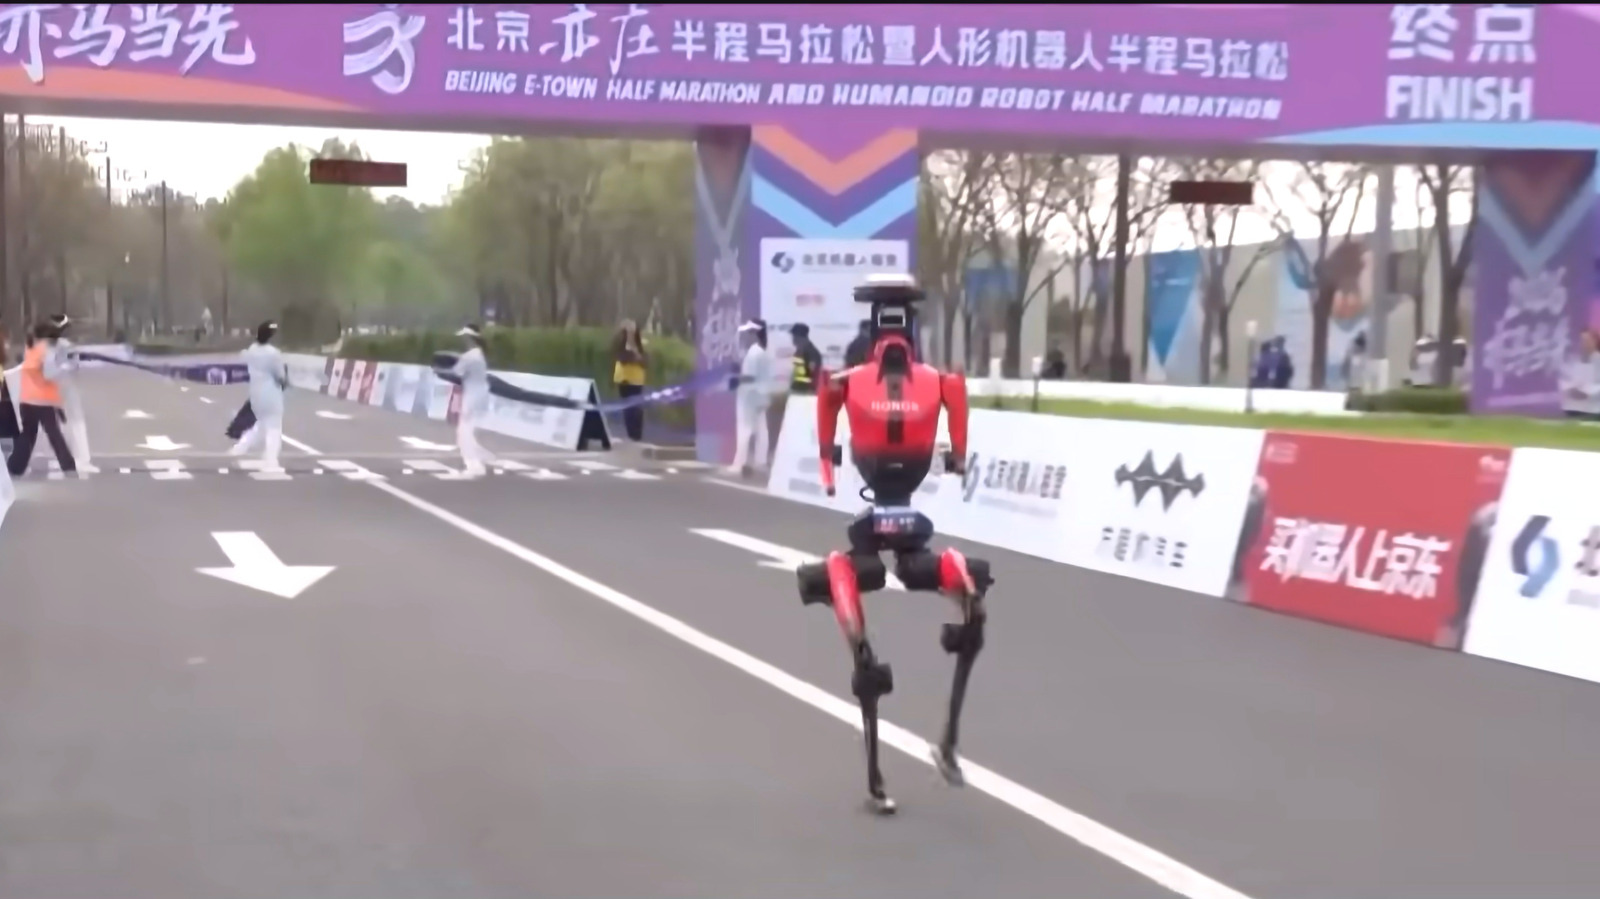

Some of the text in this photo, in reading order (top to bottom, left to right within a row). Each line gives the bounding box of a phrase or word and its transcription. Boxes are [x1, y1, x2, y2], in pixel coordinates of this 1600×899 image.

[1387, 4, 1536, 63] 终点
[445, 70, 1282, 120] BEIJING E-TOWN HALF MARATHON AND HUMANOID ROBOT HALF MARATHON
[1386, 75, 1534, 120] FINISH
